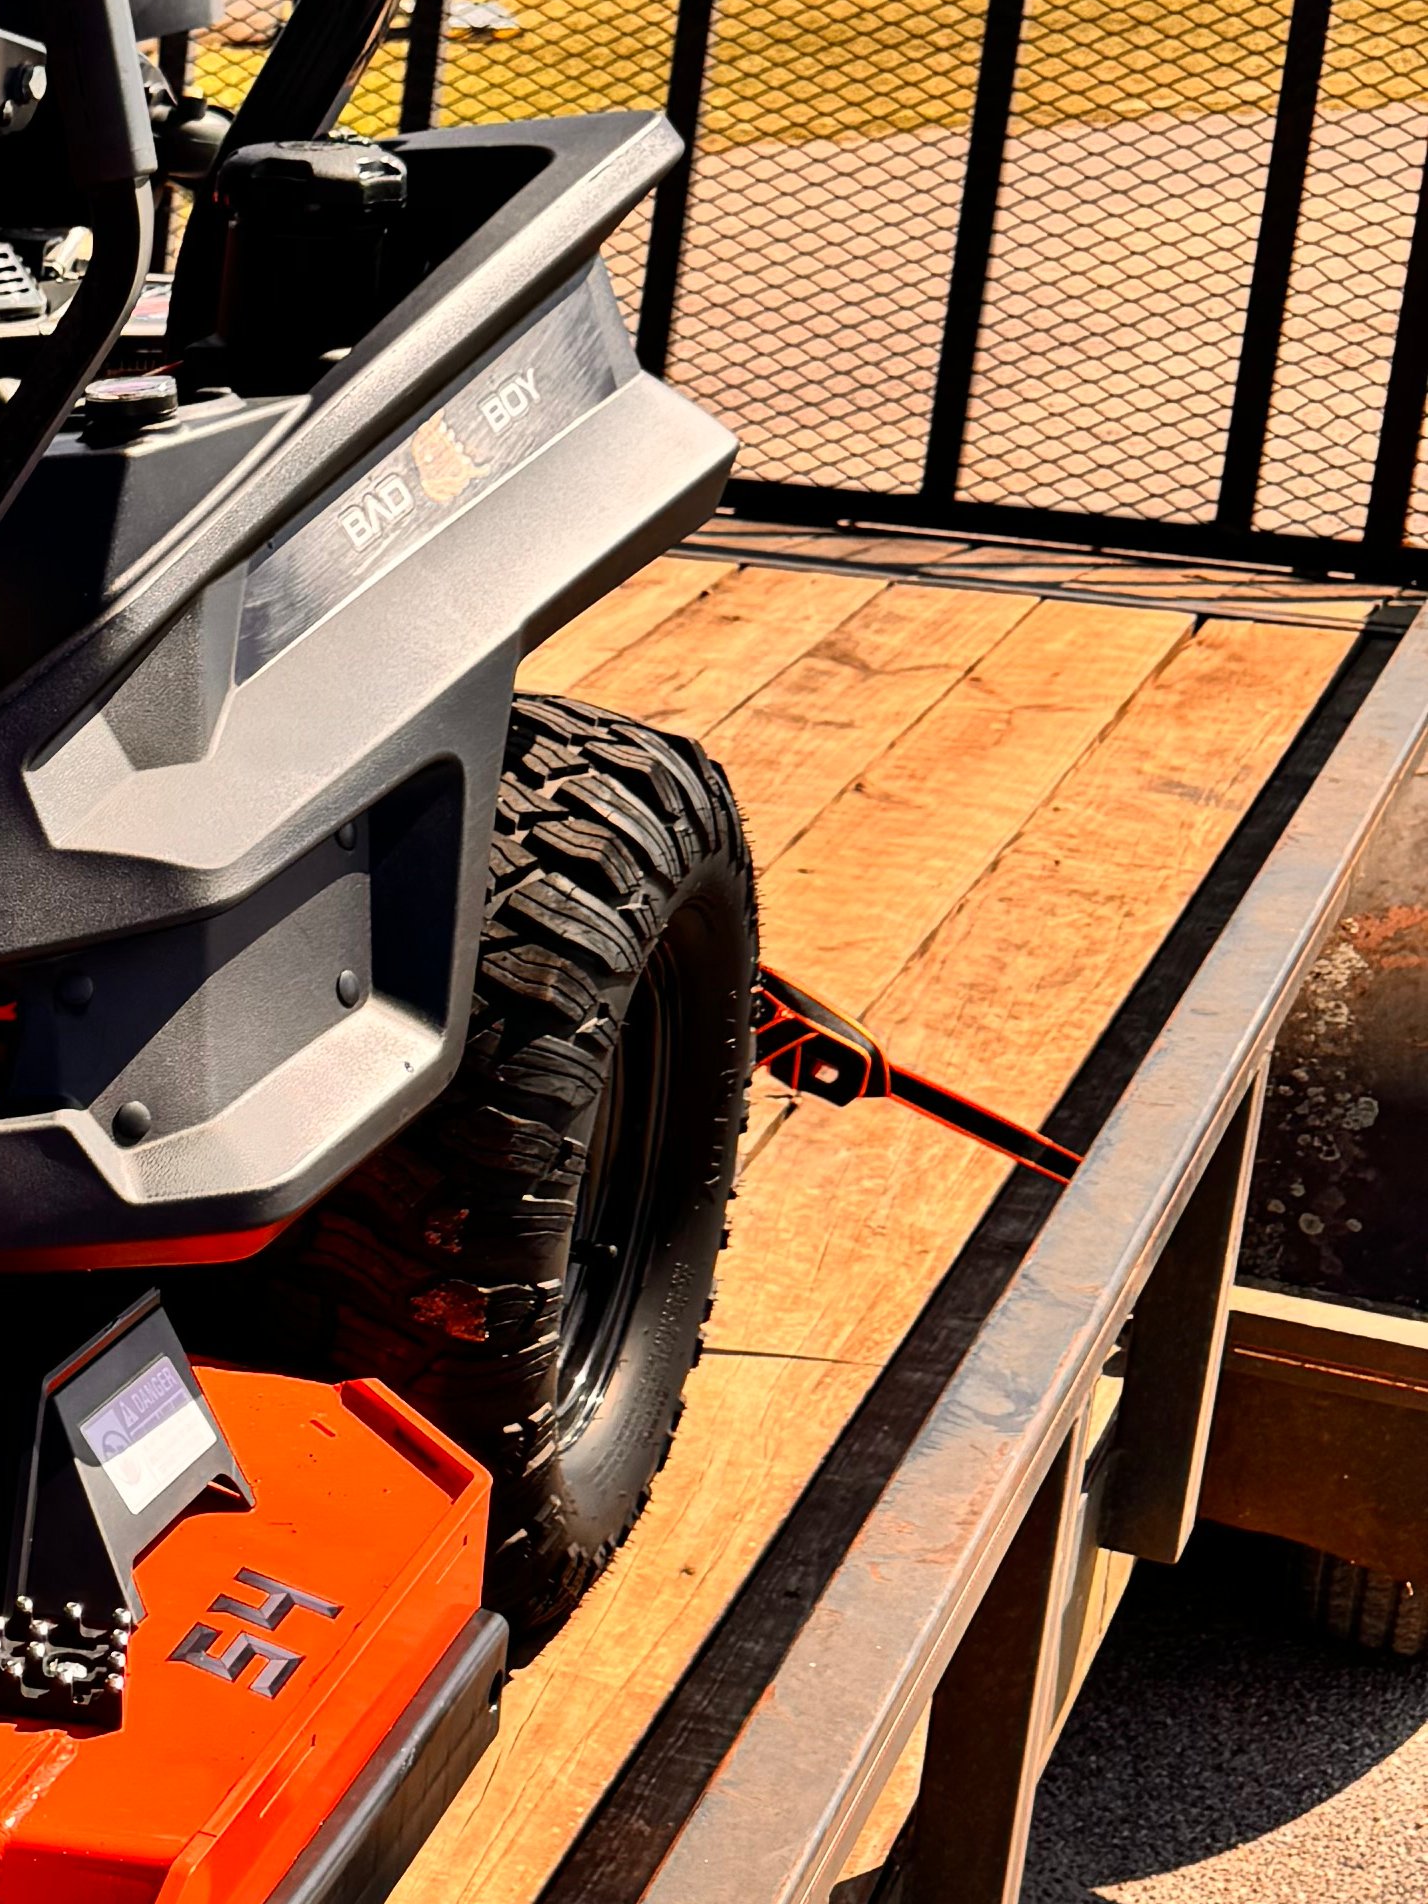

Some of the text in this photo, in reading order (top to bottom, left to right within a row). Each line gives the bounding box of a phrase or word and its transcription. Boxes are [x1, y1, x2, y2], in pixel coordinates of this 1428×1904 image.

[339, 367, 542, 552] BAD BOY
[131, 1366, 178, 1414] DANGER
[168, 1567, 345, 1700] 54
